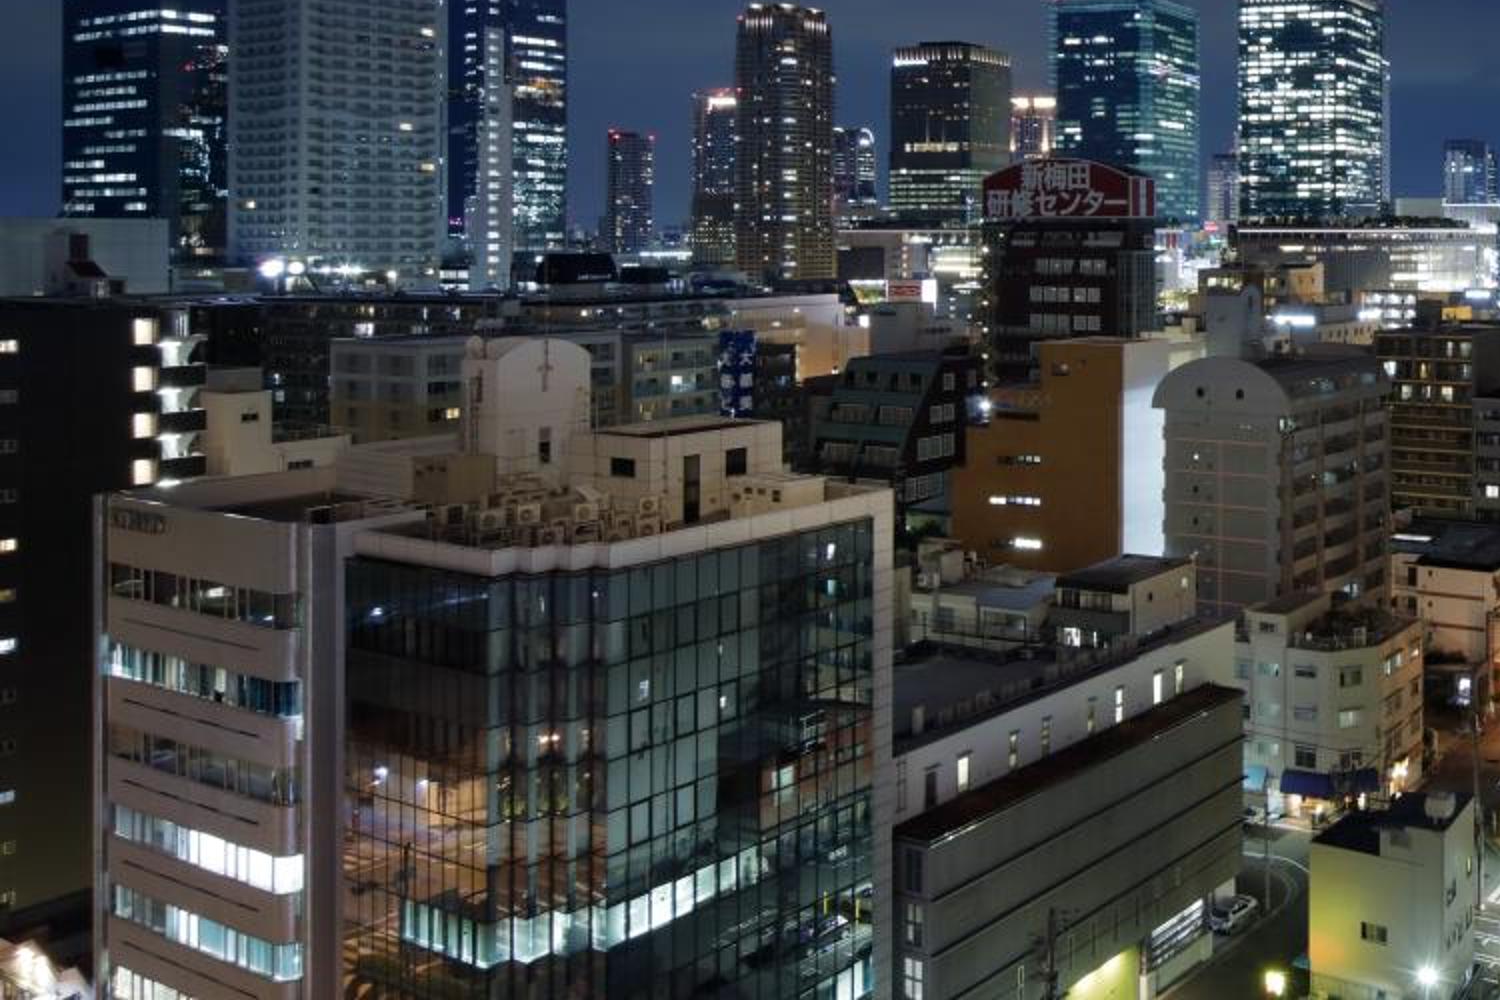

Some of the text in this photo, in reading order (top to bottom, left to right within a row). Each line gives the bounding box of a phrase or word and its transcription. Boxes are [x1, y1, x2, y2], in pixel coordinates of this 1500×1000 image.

[1022, 163, 1091, 189] 新梅田
[987, 189, 1127, 216] 研修センター
